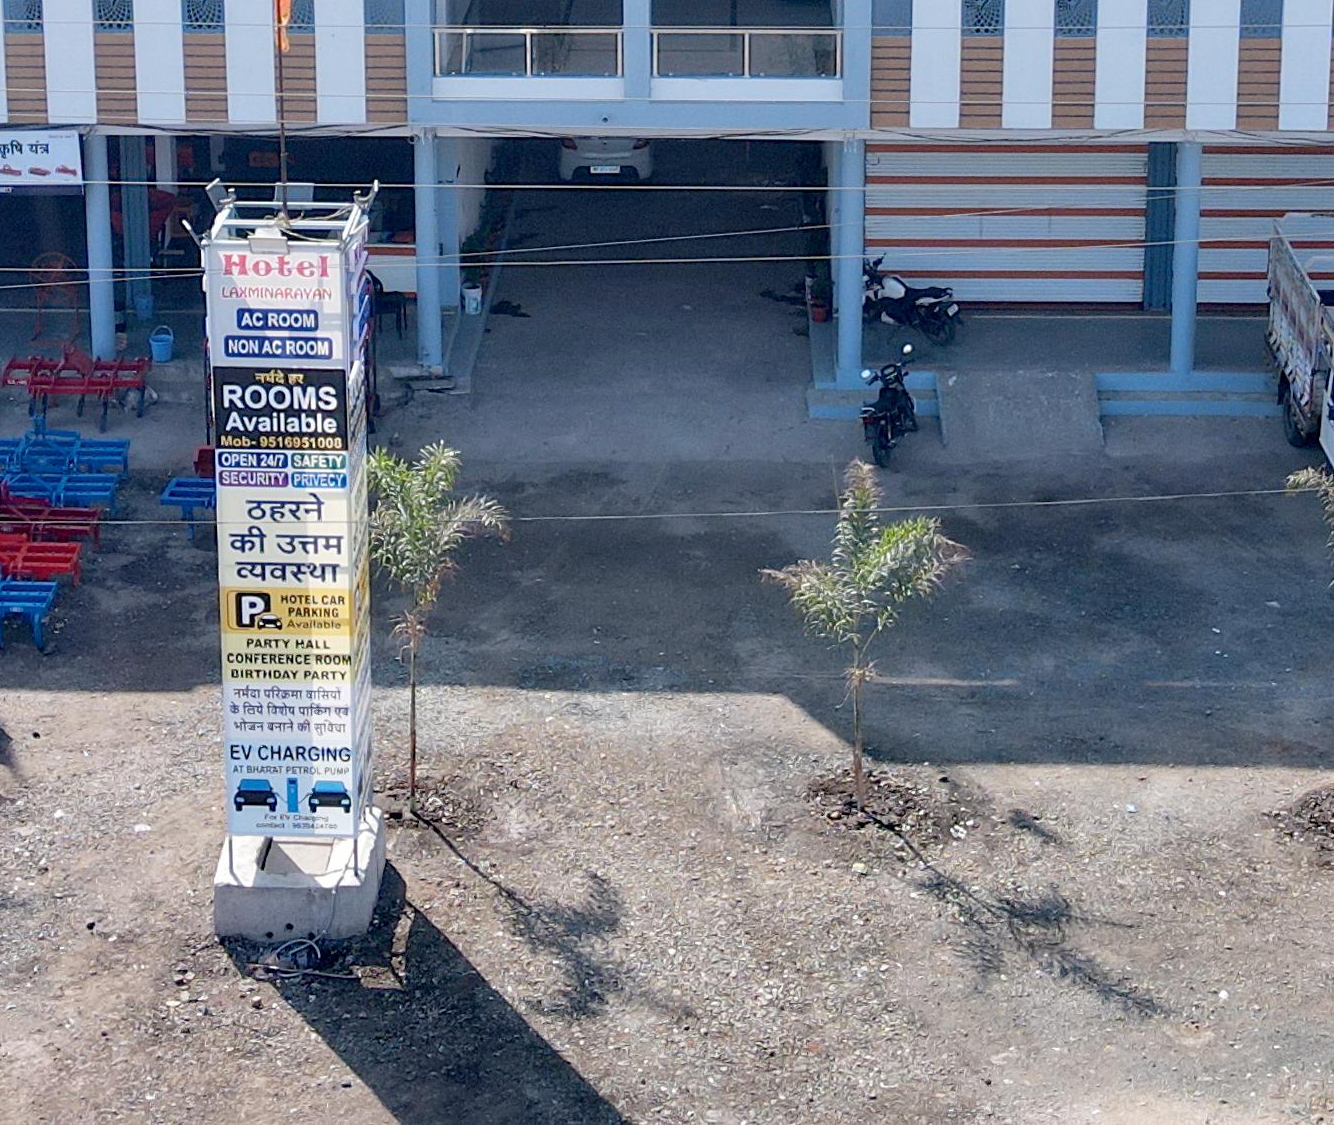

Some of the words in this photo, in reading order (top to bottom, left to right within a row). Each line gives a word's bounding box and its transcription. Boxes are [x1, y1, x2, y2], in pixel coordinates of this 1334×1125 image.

[28, 140, 50, 155] यंत्र
[222, 254, 330, 278] Hotel
[222, 286, 332, 301] LAXMINARAYAN
[241, 313, 264, 328] AC
[267, 313, 315, 329] ROOM
[228, 339, 260, 355] NON
[261, 340, 284, 355] AC
[285, 340, 329, 356] ROOM
[222, 385, 338, 412] ROOMS
[225, 411, 337, 434] Available
[259, 436, 342, 449] 9516951008
[222, 452, 258, 467] OPEN
[260, 453, 285, 468] 24/7
[293, 454, 343, 469] SAFETY
[222, 471, 286, 486] SECURITY
[294, 473, 343, 488] PRIVECY
[245, 493, 324, 522] ठहरने
[230, 526, 267, 555] की
[276, 534, 344, 555] उत्तम
[235, 561, 340, 584] व्यवस्था
[281, 595, 320, 605] HOTEL
[322, 596, 345, 605] CAR
[288, 607, 339, 618] PARKING
[286, 619, 342, 630] Available
[246, 638, 293, 649] PARTY
[296, 638, 331, 649] HALL
[227, 653, 311, 665] CONFERENCE
[314, 654, 352, 666] ROOM
[231, 669, 298, 680] BIRTHDAY
[303, 670, 348, 681] PARTY
[230, 701, 239, 715] के
[230, 745, 252, 760] EV
[258, 745, 351, 762] CHARGING
[233, 765, 244, 774] AT
[247, 765, 283, 775] BHARAT
[286, 766, 322, 775] PETROL
[324, 767, 350, 775] PUMP
